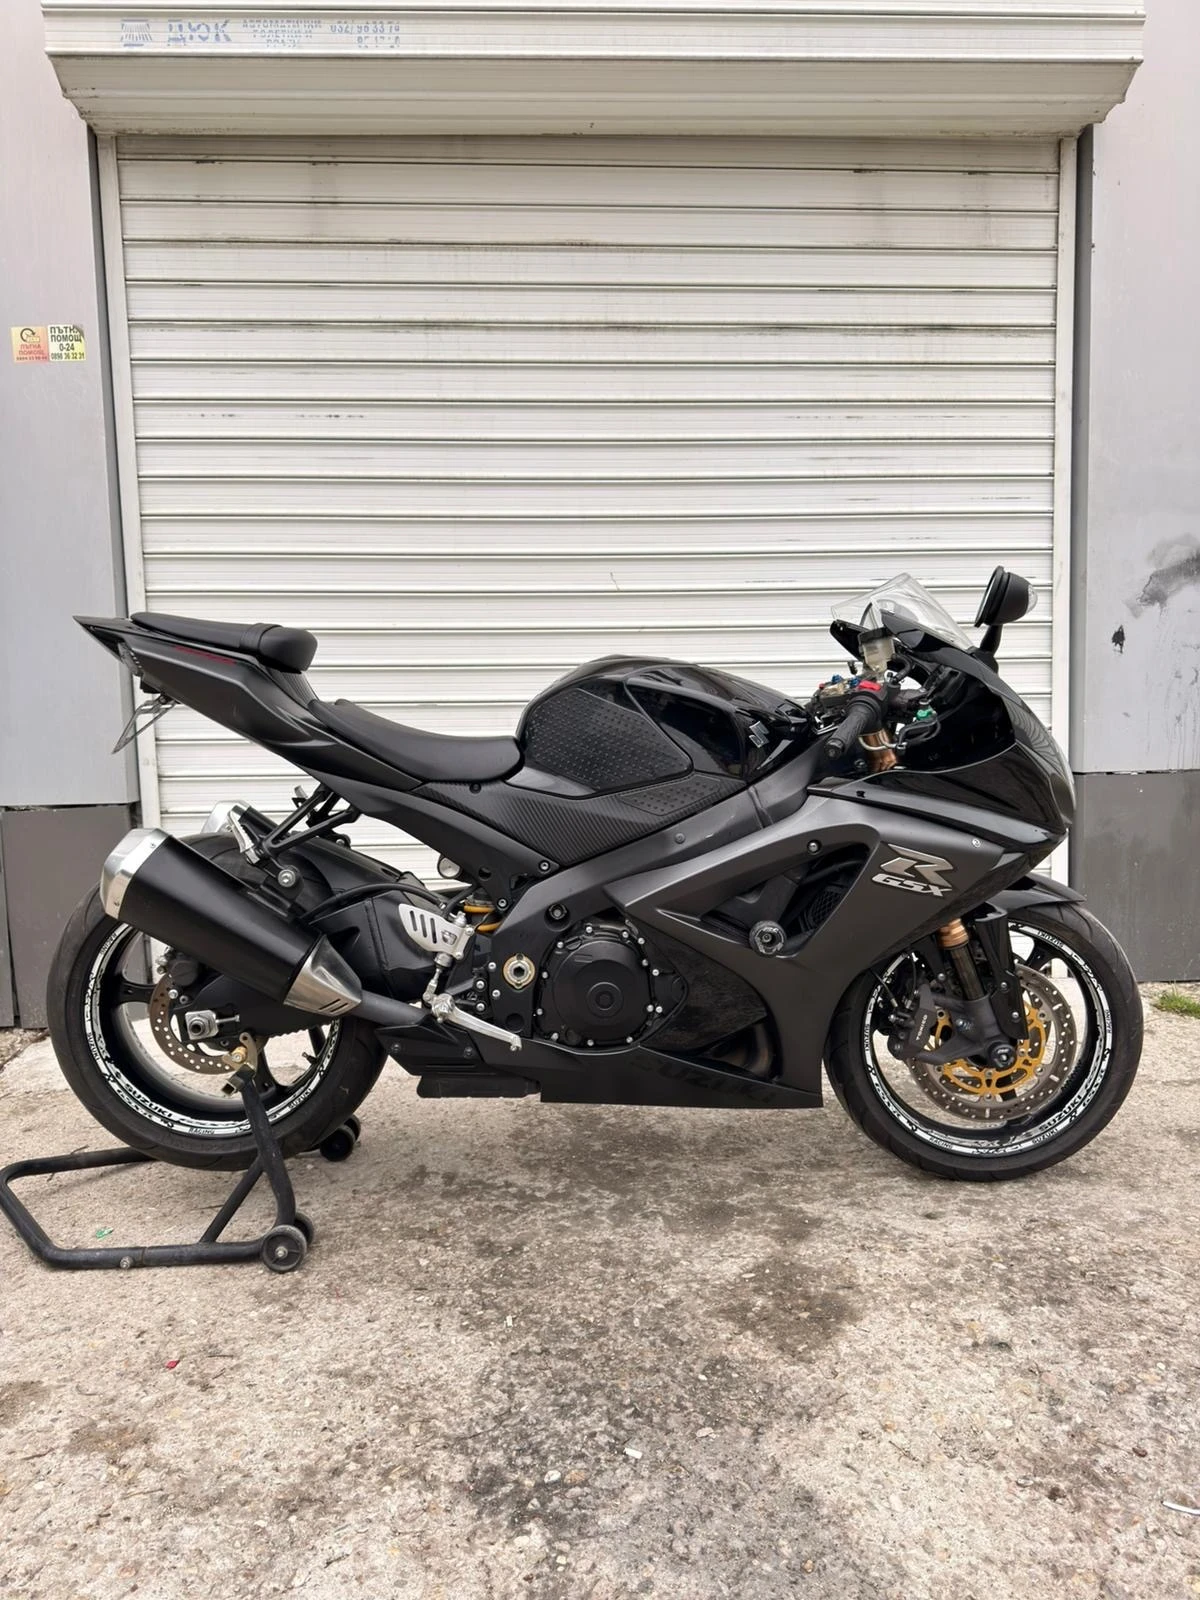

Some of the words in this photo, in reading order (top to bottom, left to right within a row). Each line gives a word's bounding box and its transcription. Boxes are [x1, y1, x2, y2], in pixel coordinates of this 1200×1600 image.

[50, 334, 82, 343] ПОМОЩ
[59, 343, 75, 352] 0-24
[872, 873, 953, 897] GSX
[87, 1032, 101, 1061] SUZUKI
[124, 1082, 173, 1118] SUZUKI
[1037, 1094, 1083, 1131] SUZUKI
[188, 1127, 216, 1136] RACING
[1031, 1128, 1059, 1145] SUZUKI
